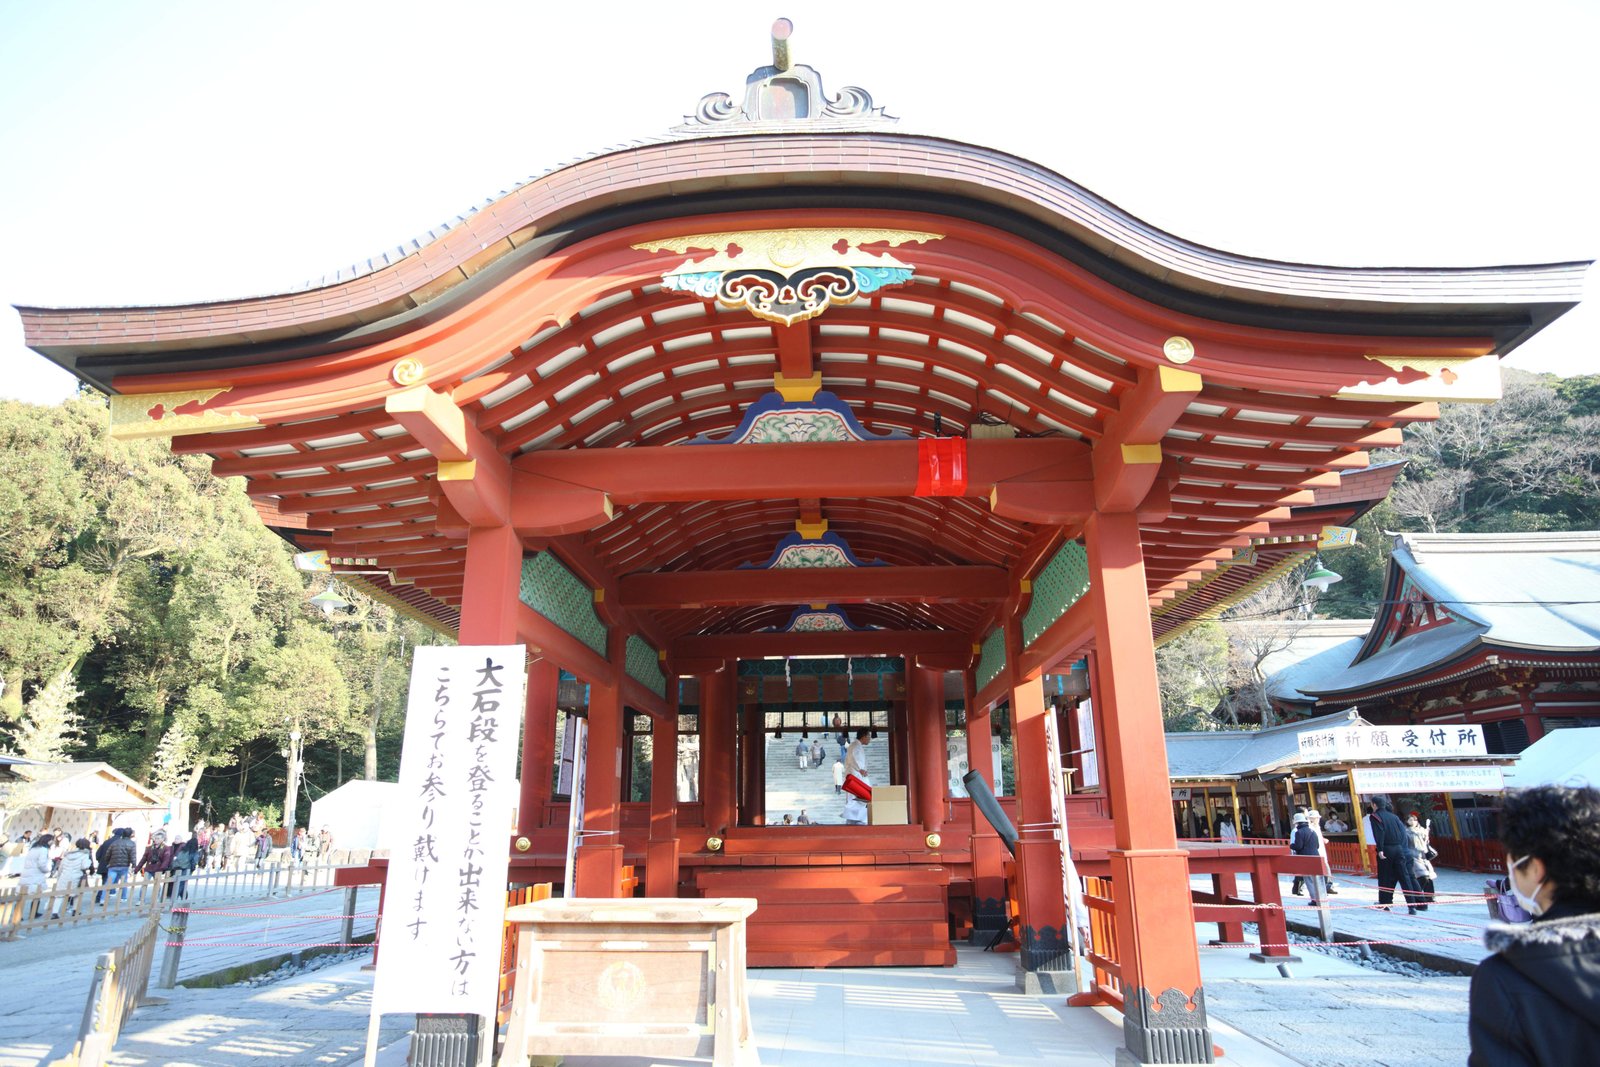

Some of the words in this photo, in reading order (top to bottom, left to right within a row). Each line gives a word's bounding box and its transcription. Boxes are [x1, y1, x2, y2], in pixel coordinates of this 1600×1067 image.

[1345, 728, 1478, 748] 祈願受付所
